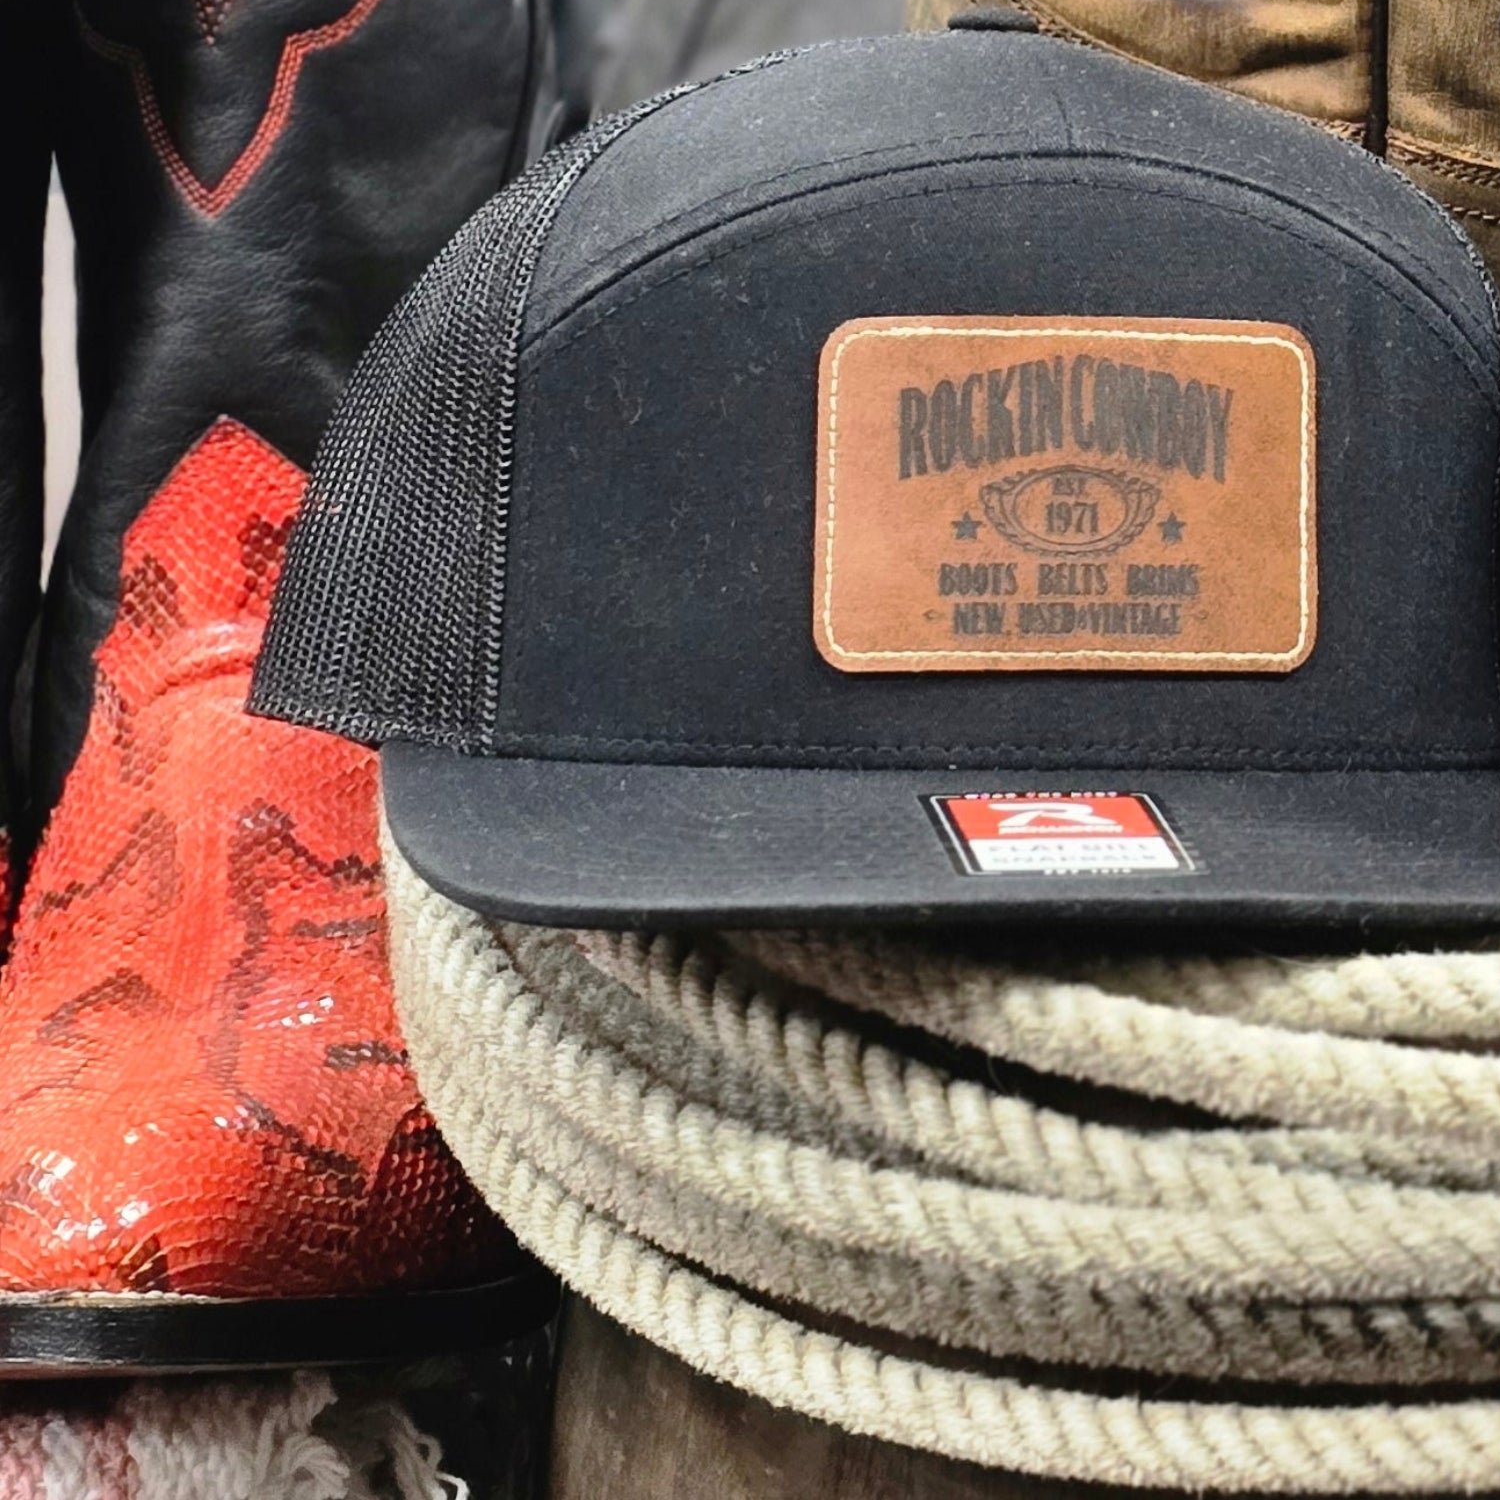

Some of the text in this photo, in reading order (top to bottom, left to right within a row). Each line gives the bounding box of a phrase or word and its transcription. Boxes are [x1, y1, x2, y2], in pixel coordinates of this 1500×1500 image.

[1045, 500, 1099, 534] 1971
[938, 562, 1018, 596] BOOTS
[1037, 562, 1108, 596] BELTS
